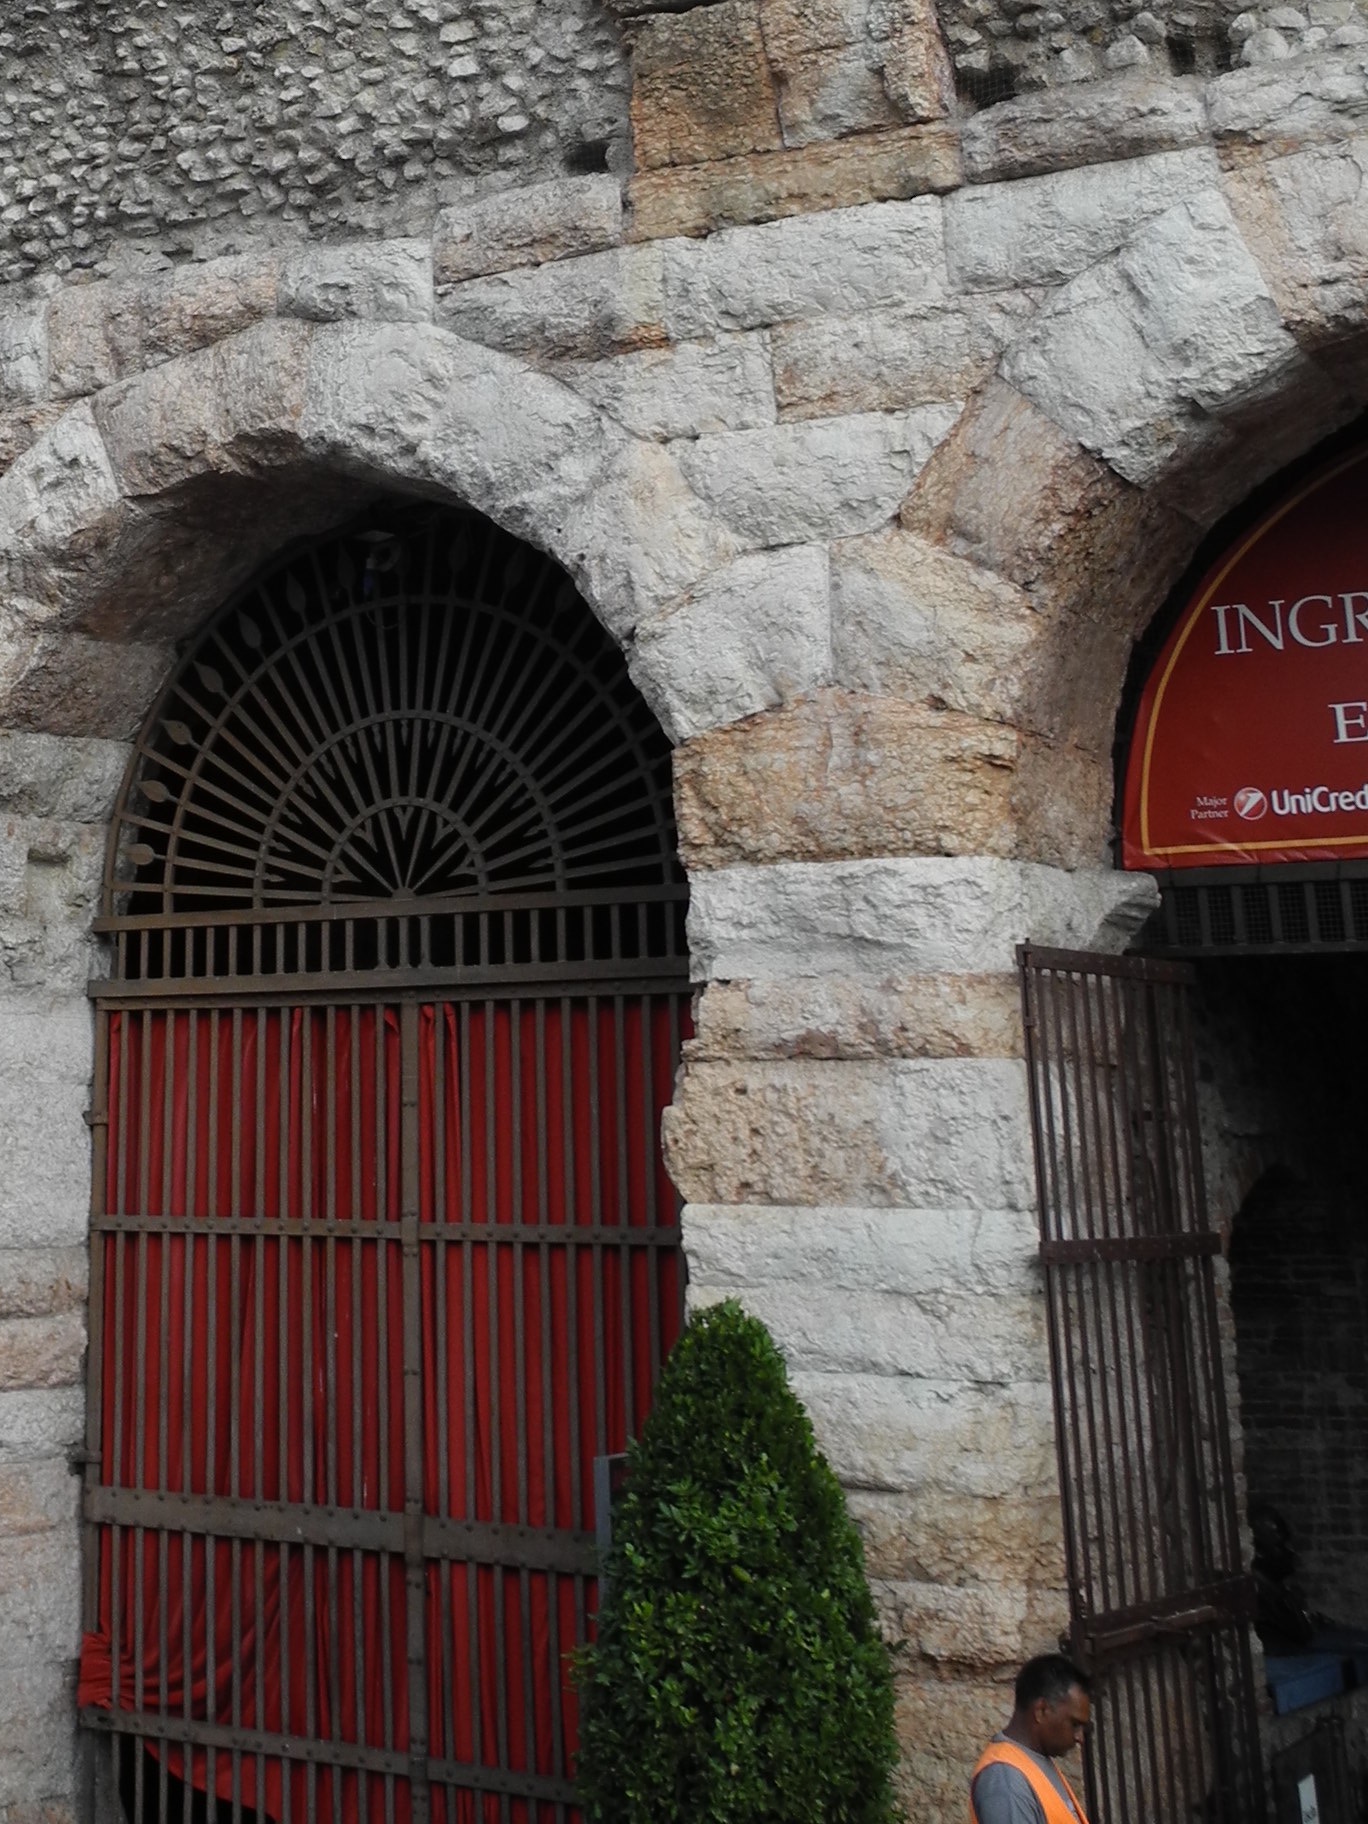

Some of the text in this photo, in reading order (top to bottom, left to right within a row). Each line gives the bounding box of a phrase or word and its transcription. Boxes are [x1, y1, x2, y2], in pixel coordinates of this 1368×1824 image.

[1328, 701, 1368, 744] E
[1196, 796, 1228, 808] Major
[1190, 809, 1229, 820] Partner
